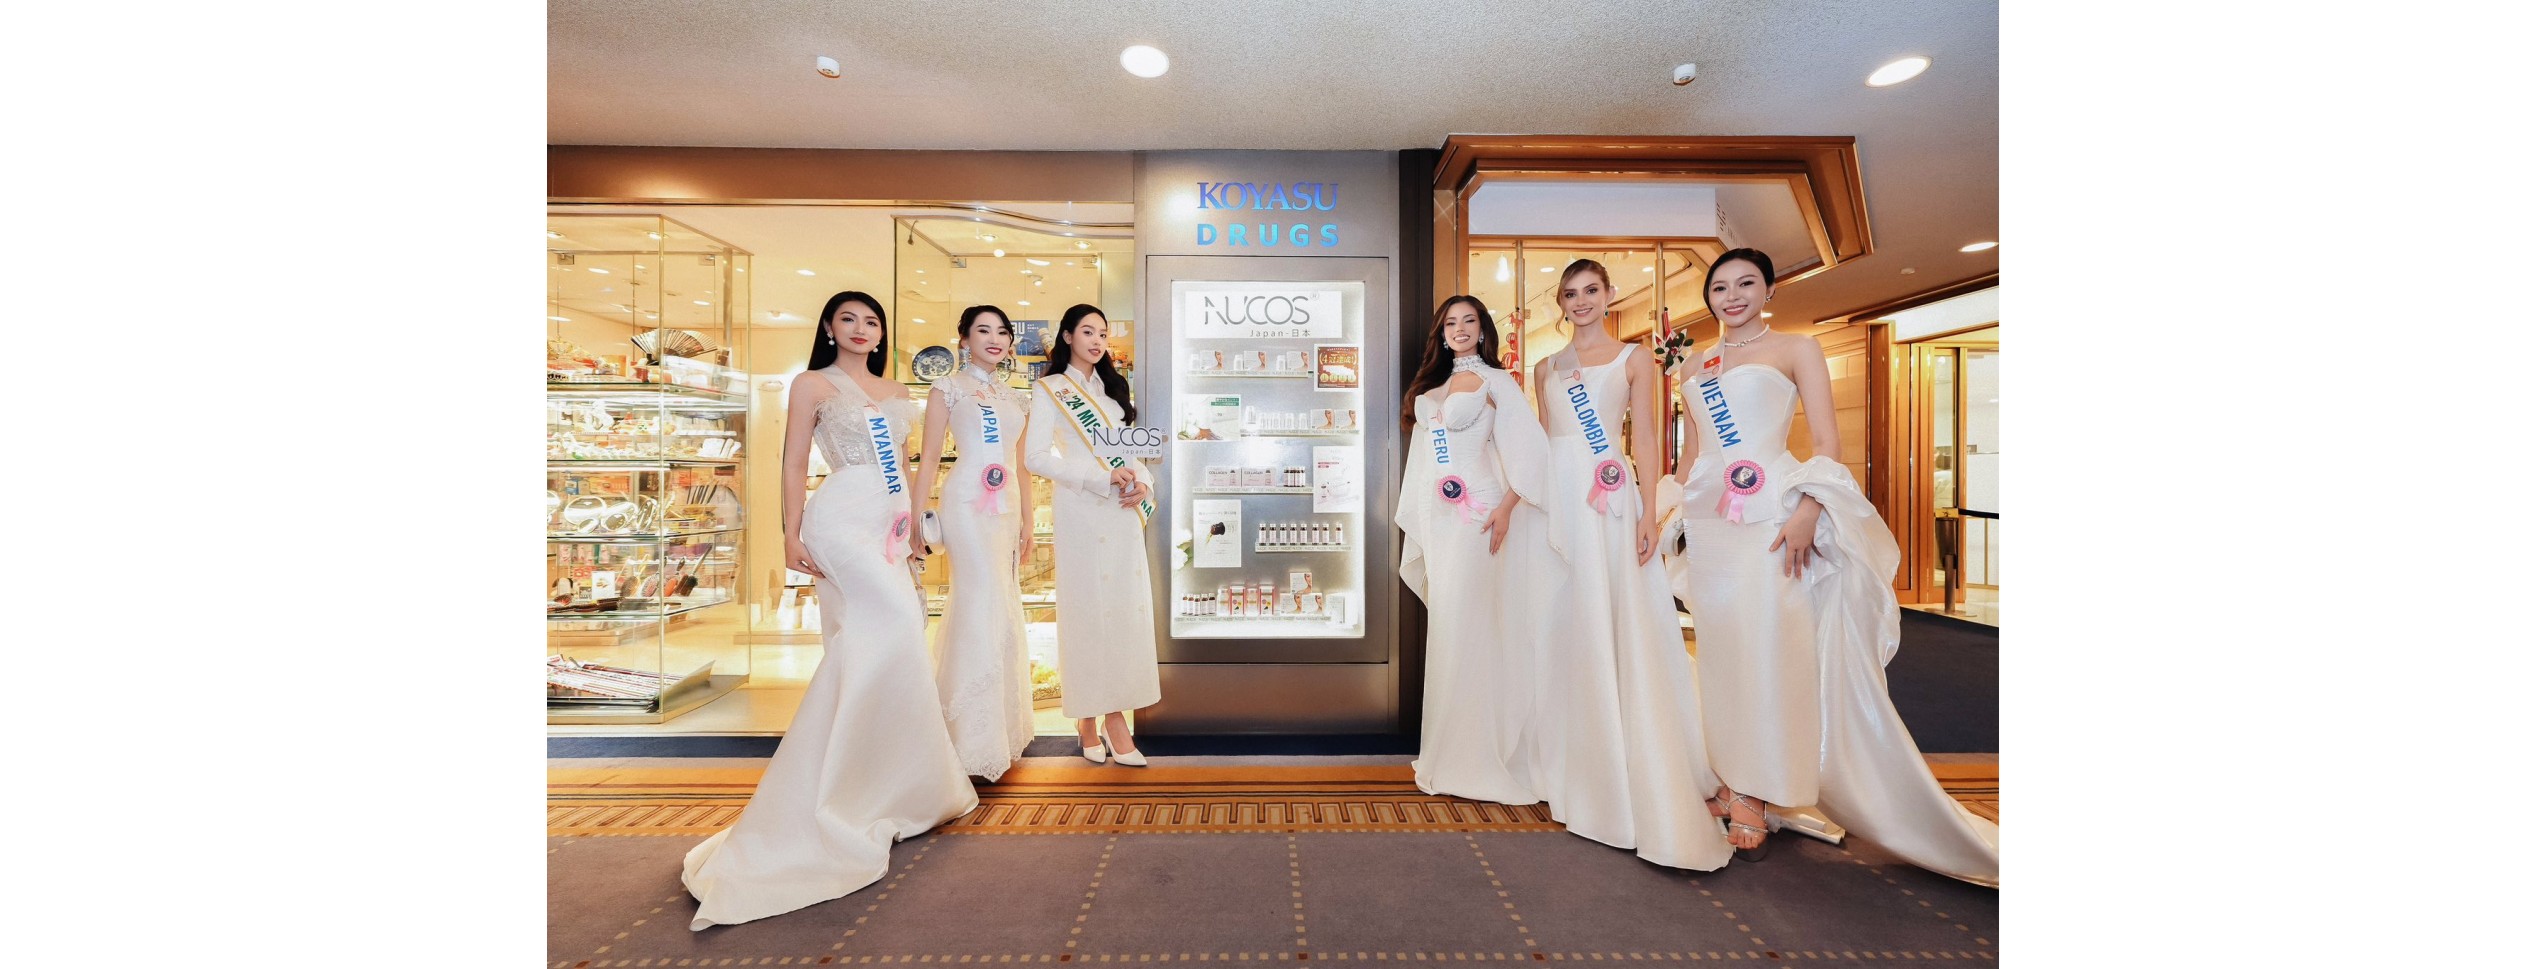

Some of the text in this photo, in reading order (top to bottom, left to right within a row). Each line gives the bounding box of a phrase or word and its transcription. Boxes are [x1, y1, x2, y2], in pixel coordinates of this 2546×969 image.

[1197, 182, 1339, 212] KOYASU
[1197, 223, 1339, 247] DRUGS
[1204, 296, 1311, 325] NUCOS
[977, 402, 999, 443] JAPAN
[1567, 383, 1609, 455] COLOMBIA
[1699, 376, 1742, 447] VIETNAM
[1093, 427, 1161, 446] NUCOS
[1431, 428, 1450, 464] PERU
[869, 417, 902, 495] MYANMAR
